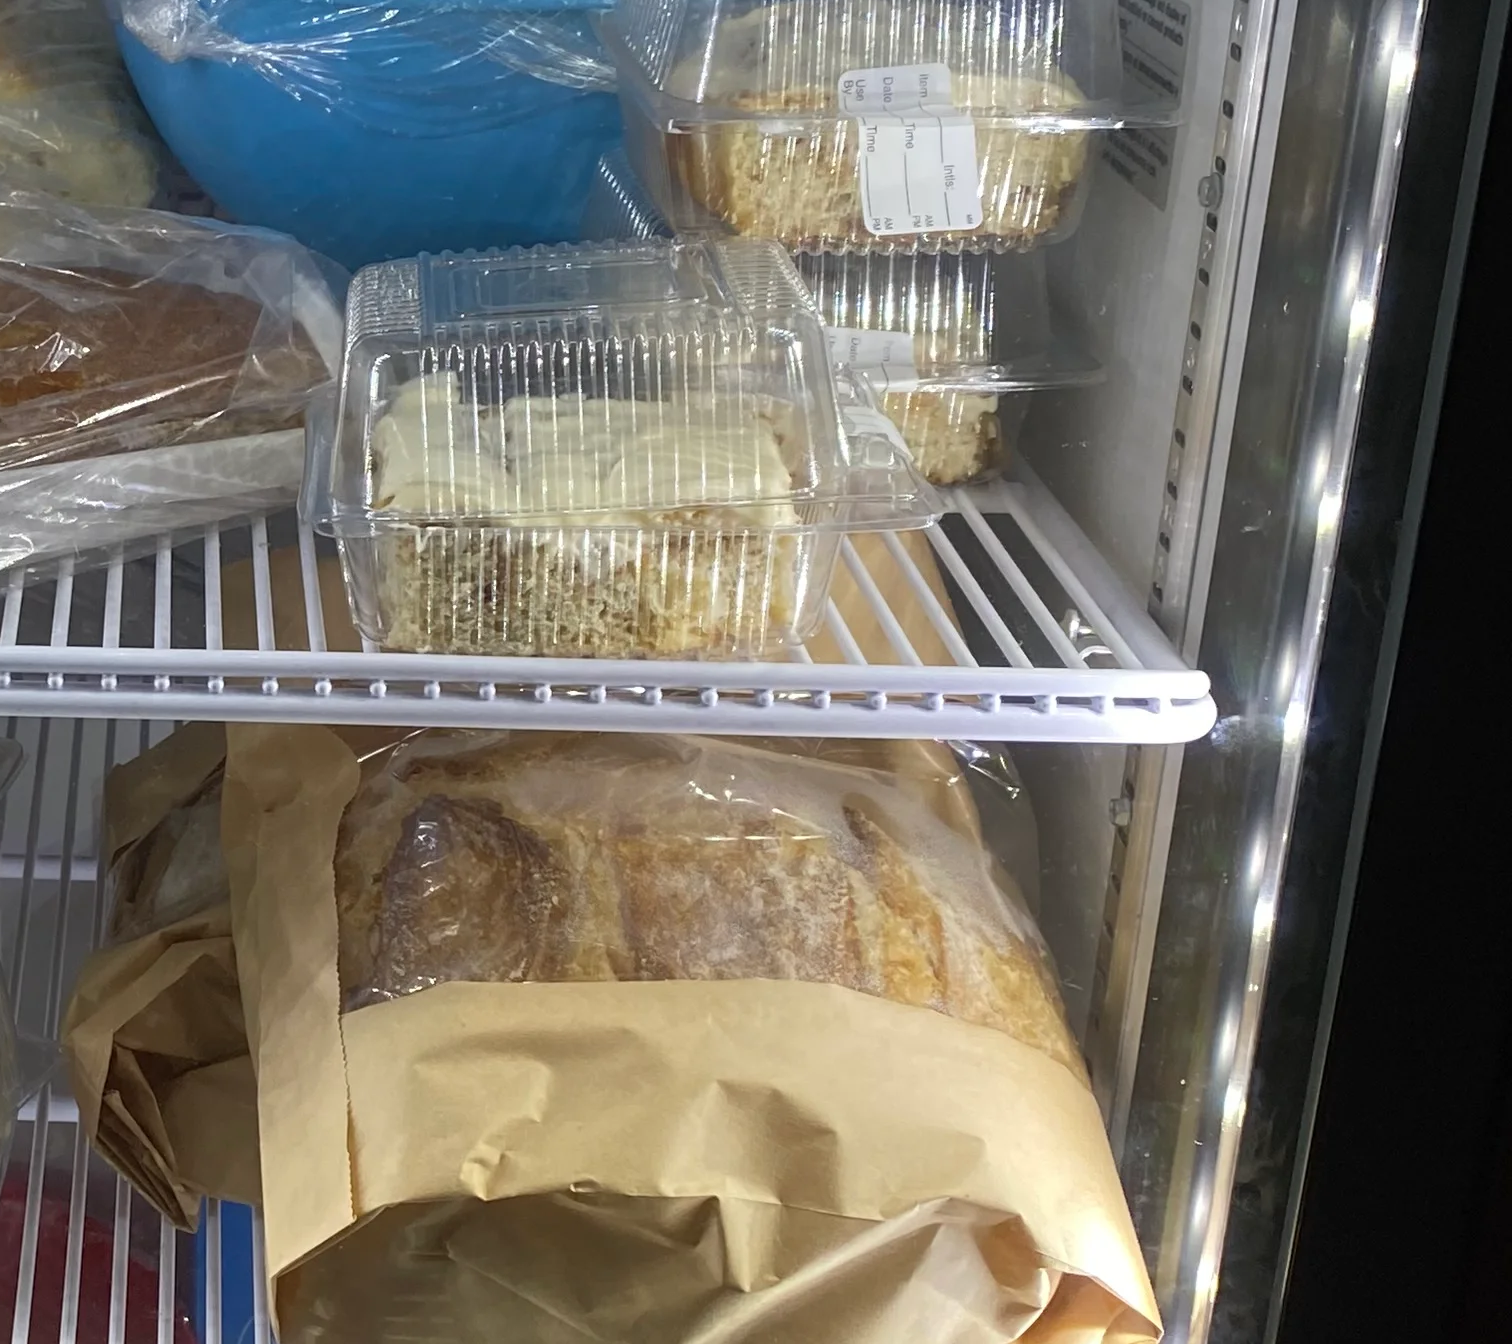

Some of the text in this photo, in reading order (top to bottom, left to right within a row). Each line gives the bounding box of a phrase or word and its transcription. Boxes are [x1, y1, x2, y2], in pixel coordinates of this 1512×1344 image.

[843, 80, 882, 231] By PM
[855, 79, 894, 231] Use Time AM
[883, 76, 934, 228] Date Time AM
[919, 73, 929, 98] Item
[912, 215, 922, 229] PM
